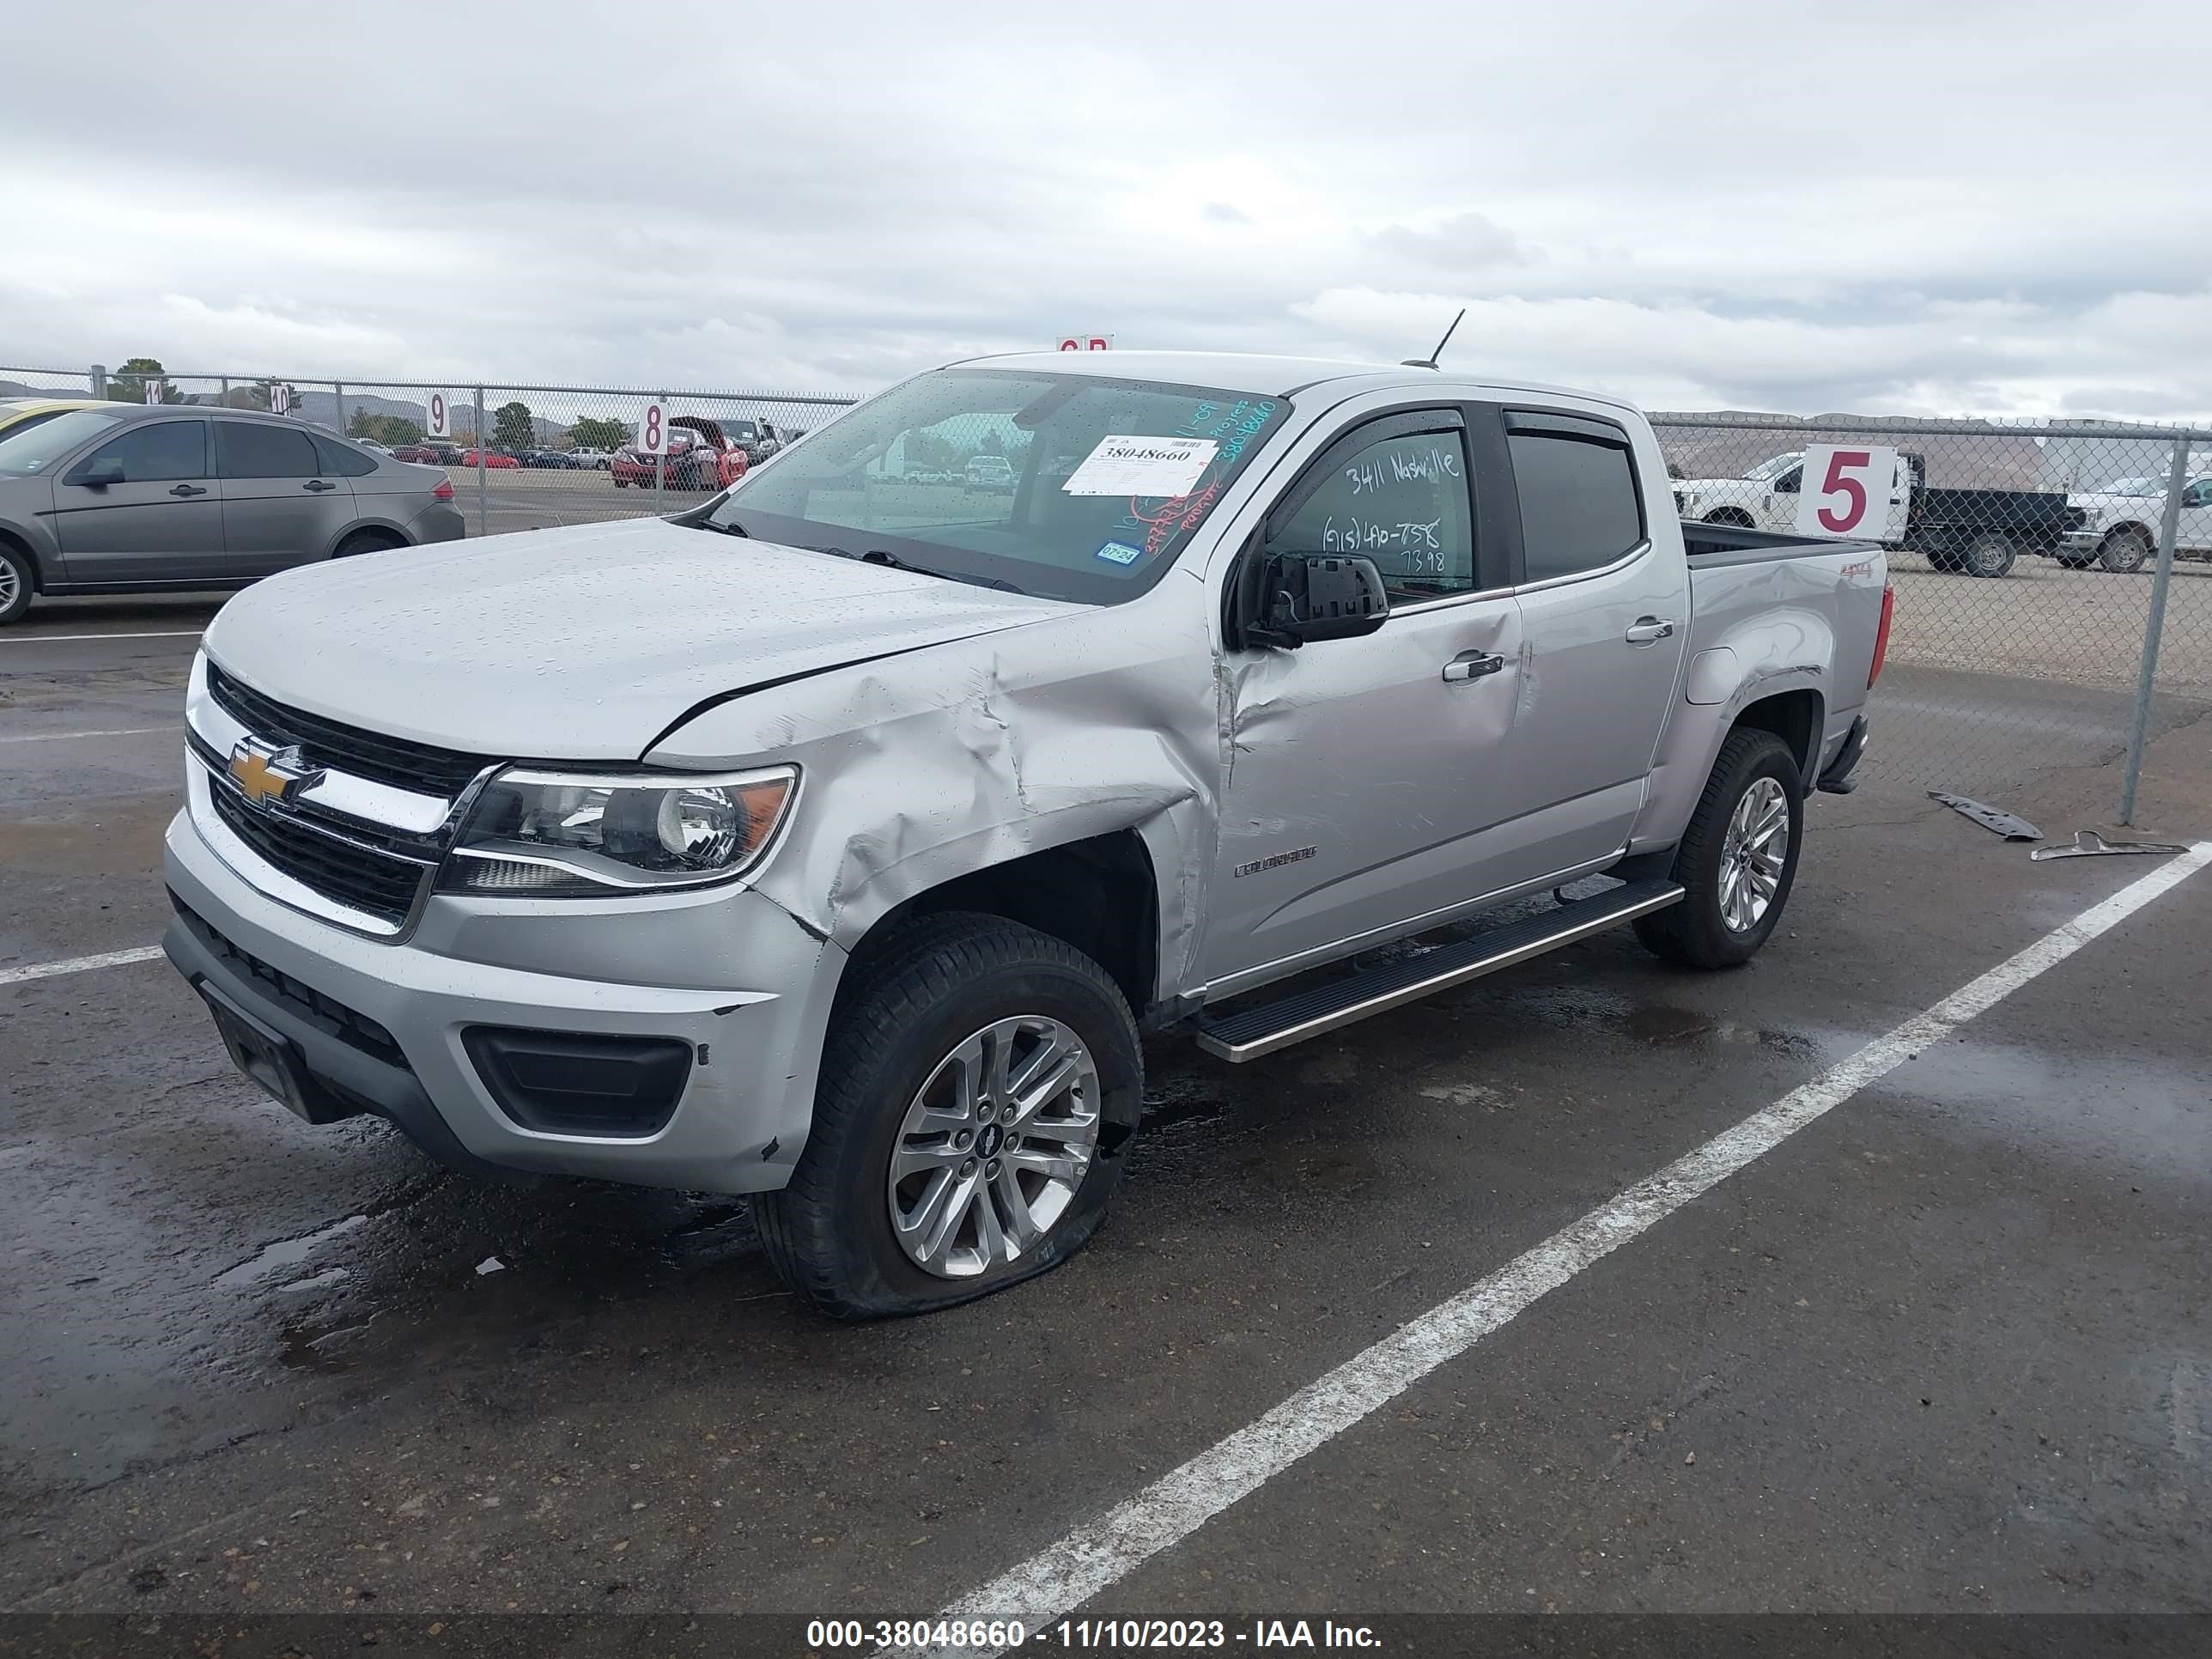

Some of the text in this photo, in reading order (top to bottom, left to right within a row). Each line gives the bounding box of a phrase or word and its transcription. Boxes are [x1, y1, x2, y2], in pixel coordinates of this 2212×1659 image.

[146, 382, 162, 404] 11
[272, 387, 289, 416] 10
[431, 393, 444, 434] 9
[645, 404, 661, 451] 8
[1174, 402, 1219, 436] 11-09
[1216, 400, 1276, 463] 38048660
[1101, 447, 1191, 462] 38048660
[1346, 447, 1460, 495] 3411 Nashville
[1817, 451, 1870, 533] 5
[1401, 550, 1444, 572] 7398
